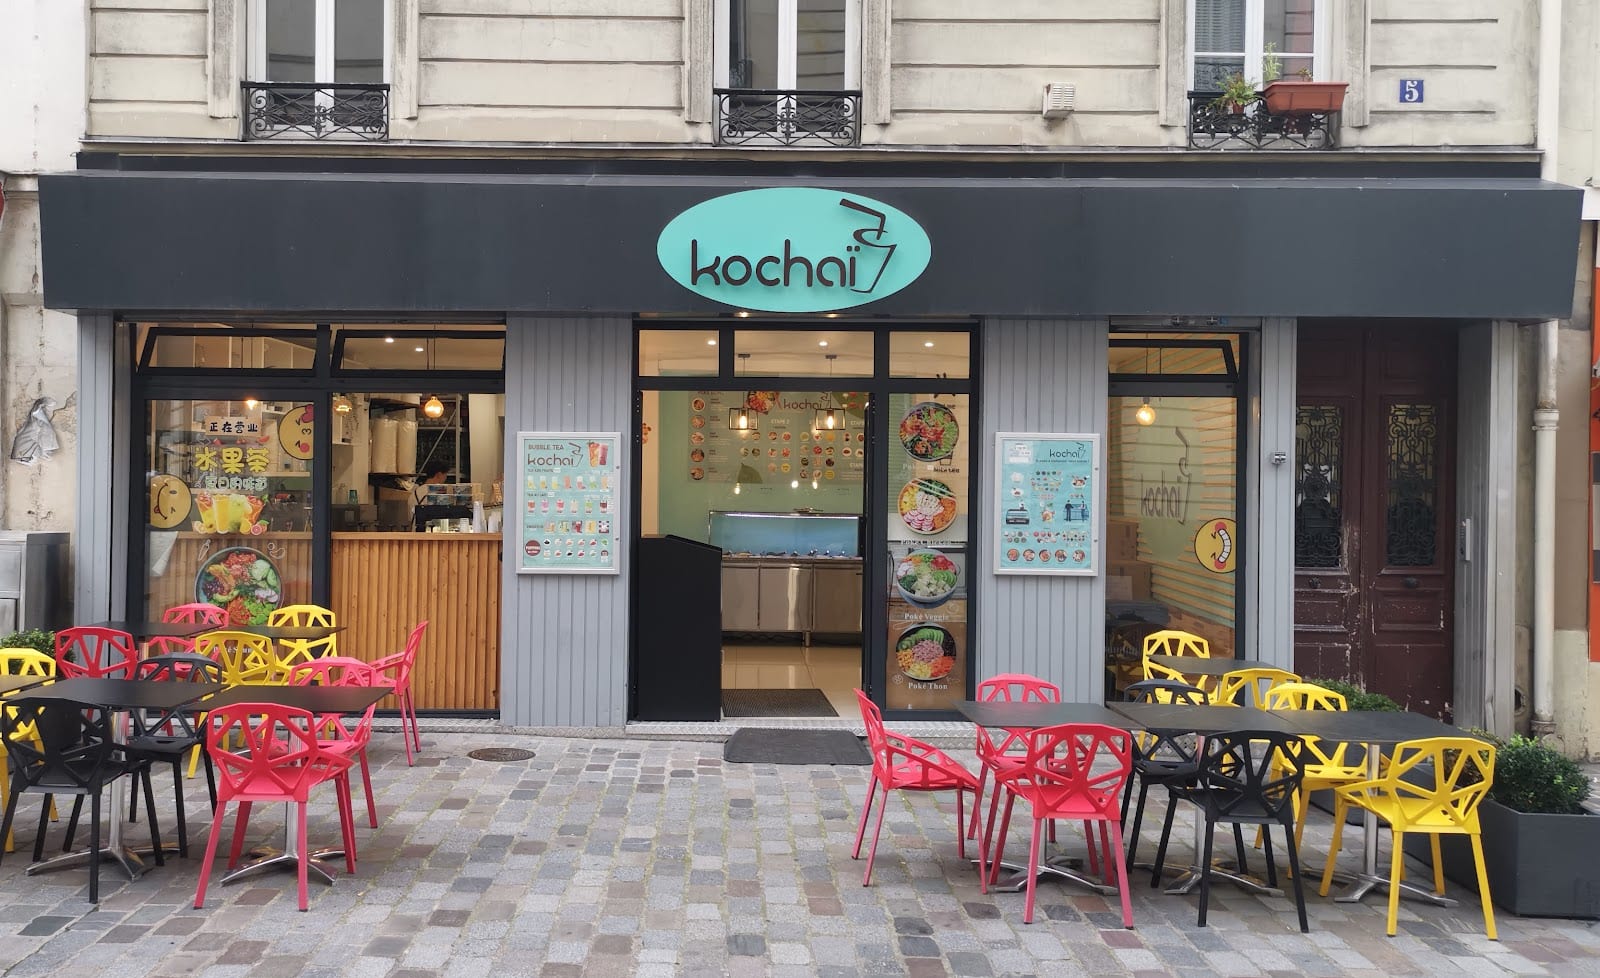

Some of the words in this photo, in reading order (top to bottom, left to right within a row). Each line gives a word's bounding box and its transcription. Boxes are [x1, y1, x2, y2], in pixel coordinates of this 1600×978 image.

[1405, 80, 1419, 102] 5
[691, 238, 861, 287] kochaï
[209, 421, 258, 433] 正在营业
[195, 446, 269, 474] 水果茶
